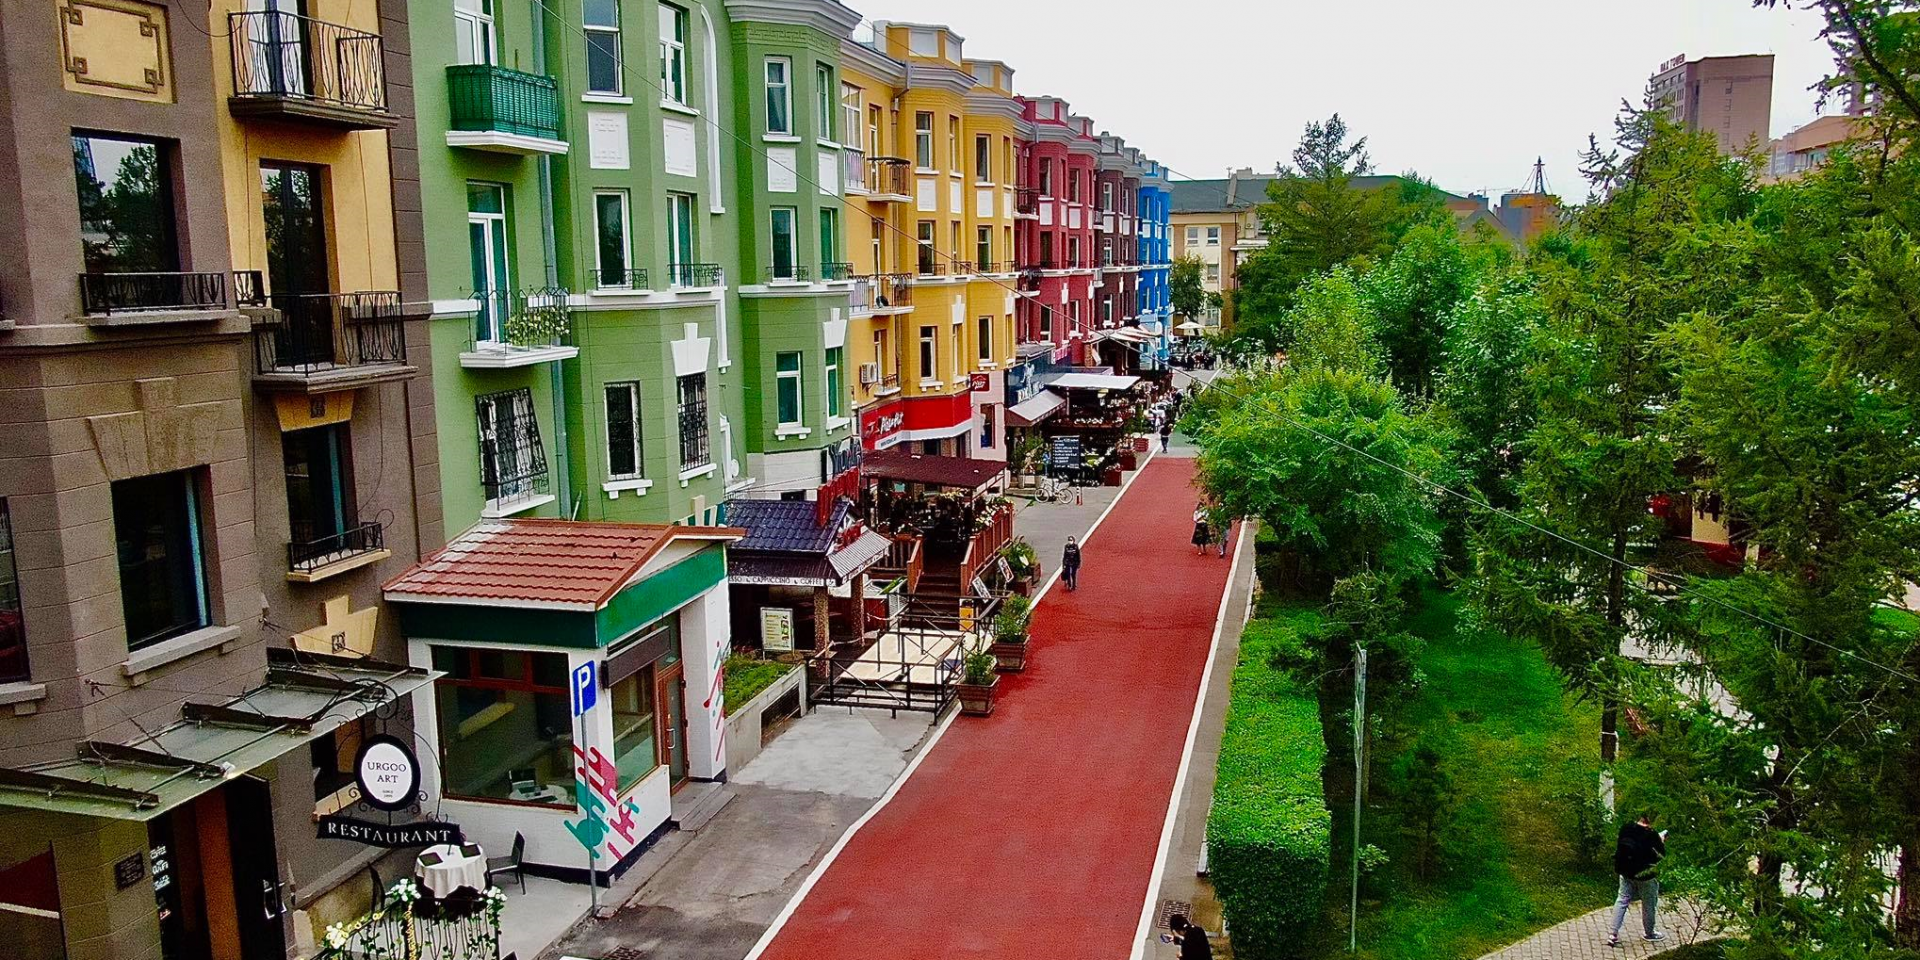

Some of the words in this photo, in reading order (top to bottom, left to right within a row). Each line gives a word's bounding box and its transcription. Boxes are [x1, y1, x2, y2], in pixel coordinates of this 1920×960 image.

[367, 762, 407, 772] URGOO
[377, 774, 398, 783] ART
[328, 822, 451, 844] RESTAURANT
